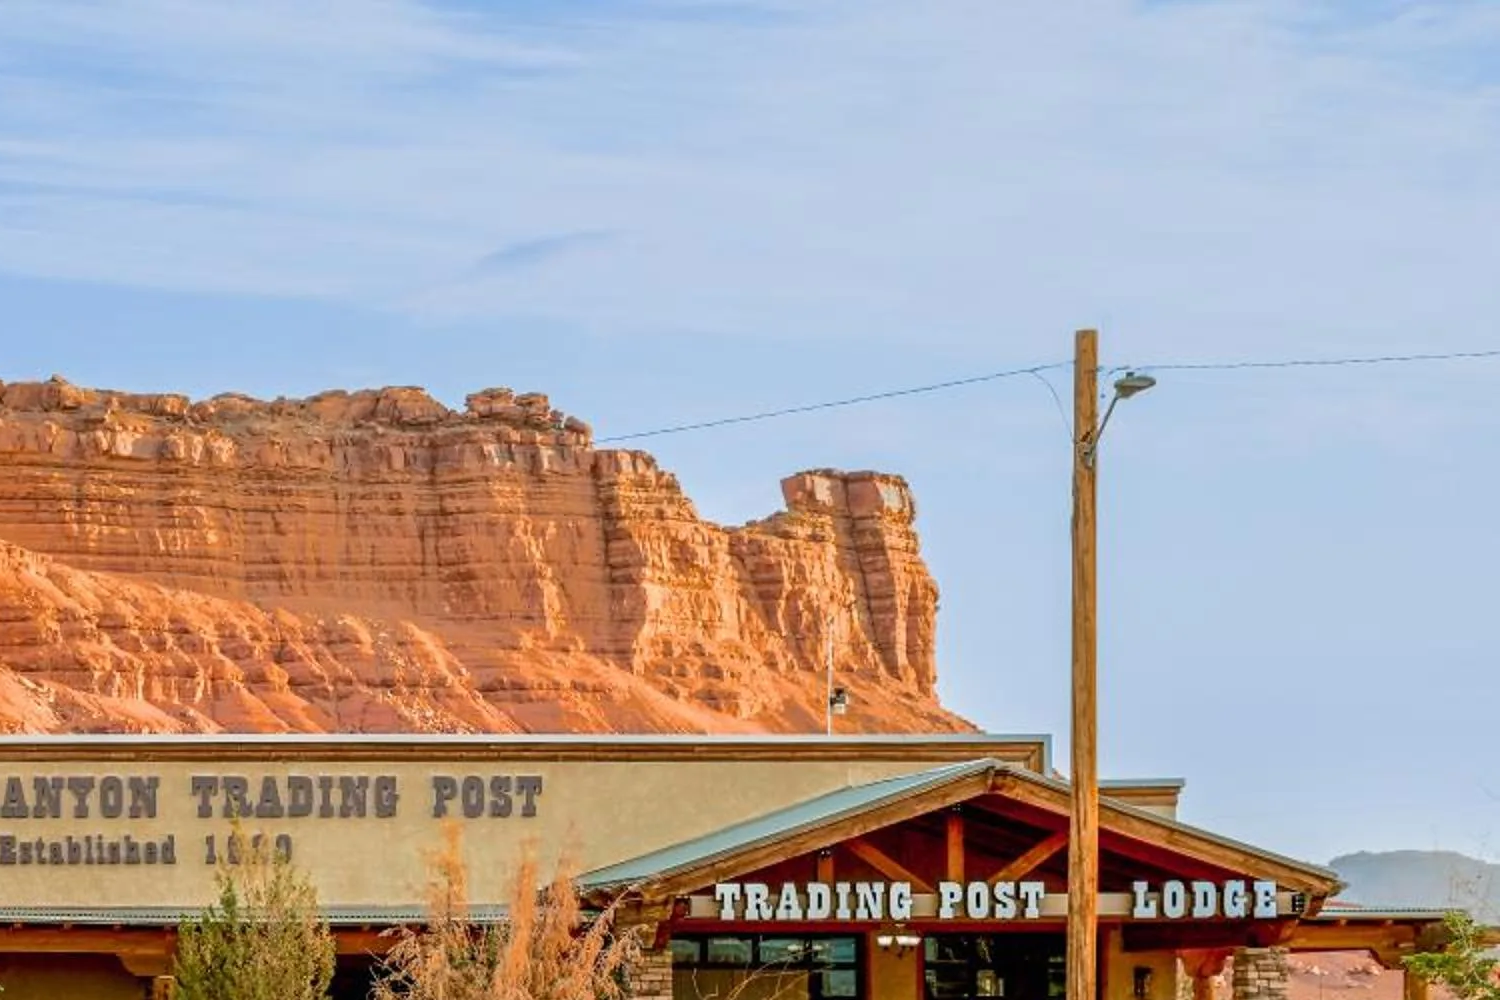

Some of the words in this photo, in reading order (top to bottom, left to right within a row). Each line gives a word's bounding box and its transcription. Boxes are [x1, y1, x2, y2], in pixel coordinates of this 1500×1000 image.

[191, 775, 400, 818] TRADING
[432, 775, 543, 818] POST
[714, 881, 913, 921] TRADING
[938, 881, 1045, 919] POST
[1132, 879, 1277, 919] LODGE
